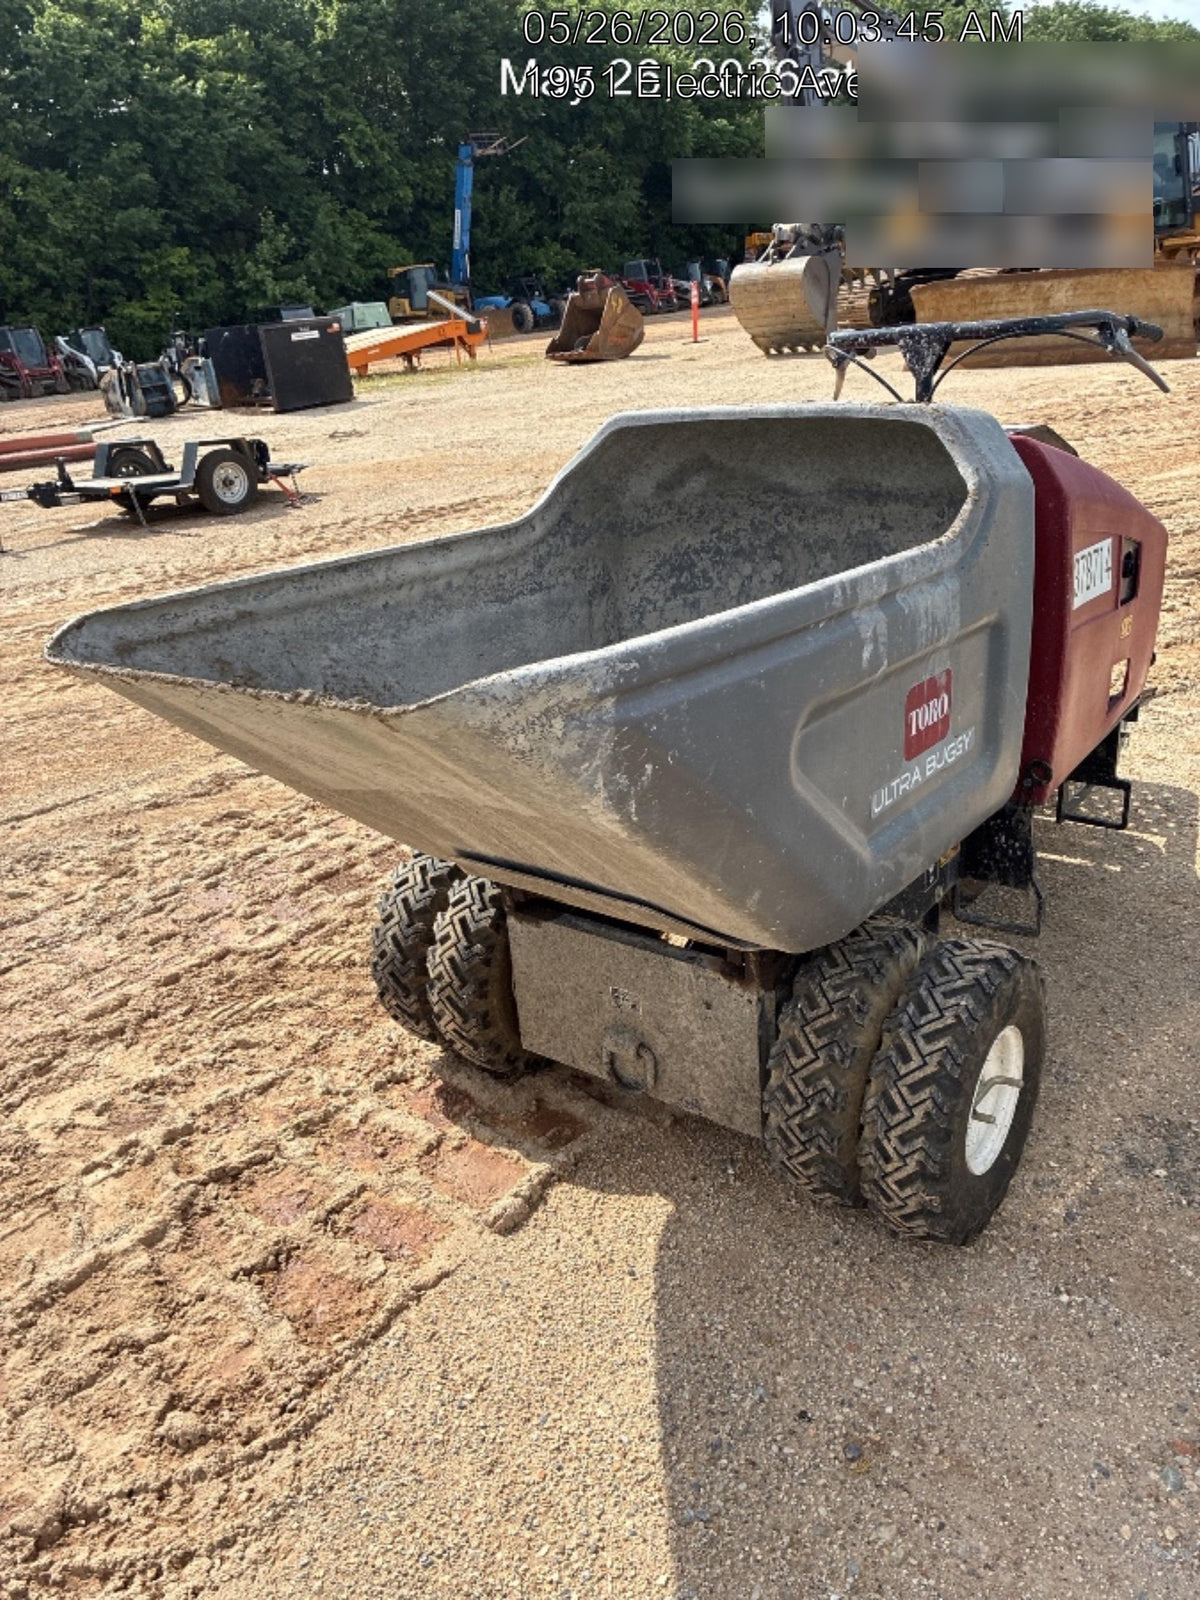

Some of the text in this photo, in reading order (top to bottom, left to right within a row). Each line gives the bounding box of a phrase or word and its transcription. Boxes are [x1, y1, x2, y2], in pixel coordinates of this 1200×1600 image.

[909, 692, 949, 737] TORO
[870, 729, 975, 815] ULTRA BUGGY
